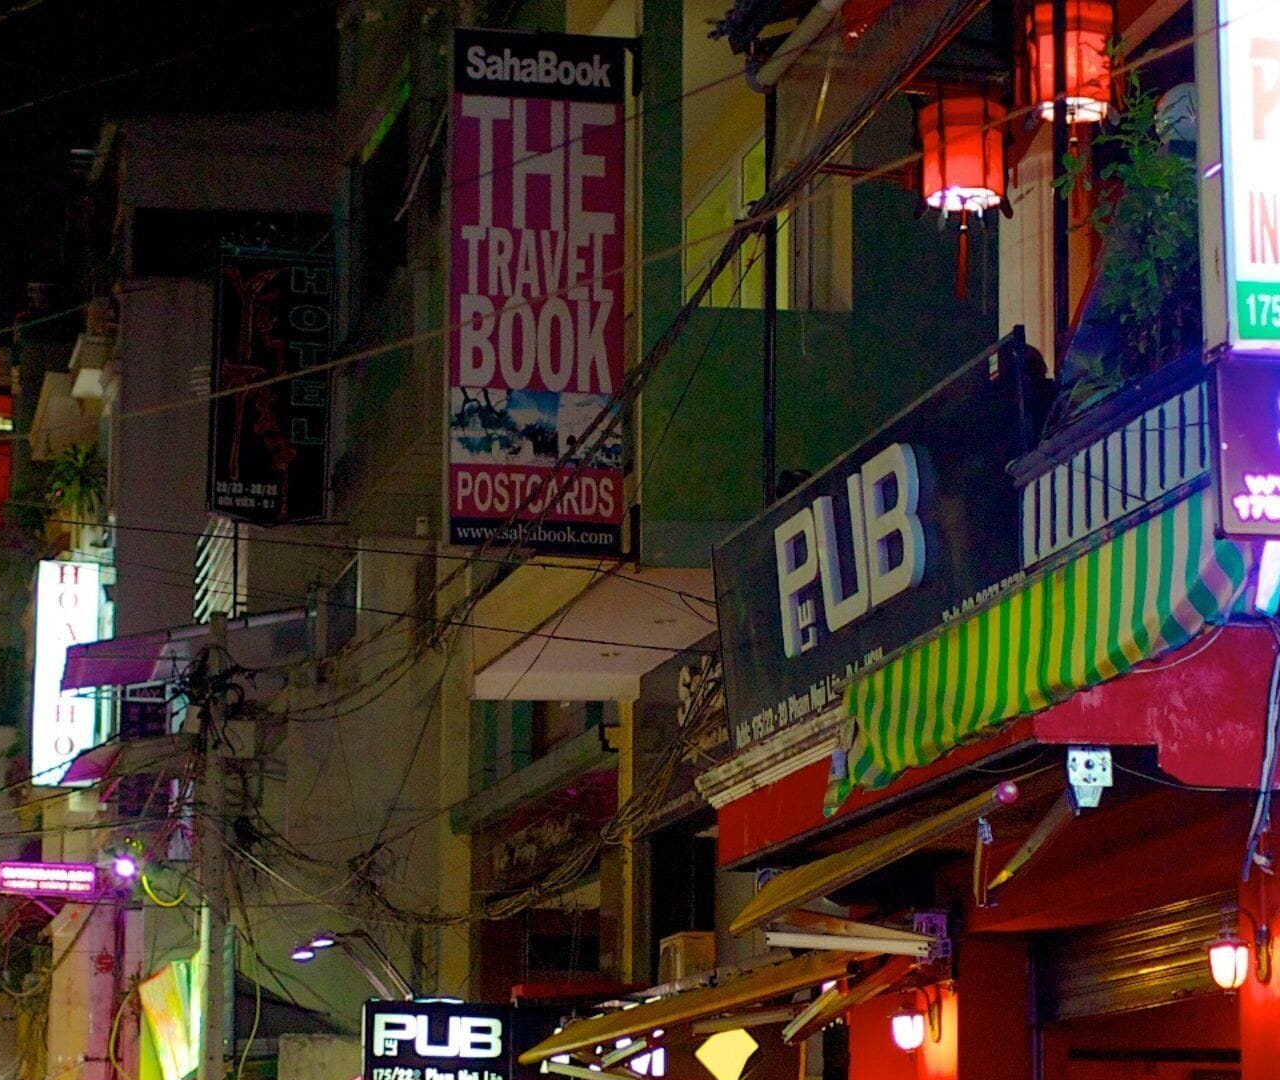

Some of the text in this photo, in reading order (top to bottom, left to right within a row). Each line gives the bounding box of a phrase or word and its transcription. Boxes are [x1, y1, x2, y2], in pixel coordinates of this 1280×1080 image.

[465, 44, 612, 88] SahaBook
[461, 95, 617, 234] THE
[461, 225, 615, 302] TRAVEL
[459, 293, 614, 393] BOOK
[456, 470, 615, 518] POSTCARDS
[774, 442, 927, 659] PUB
[372, 1012, 503, 1058] PUB
